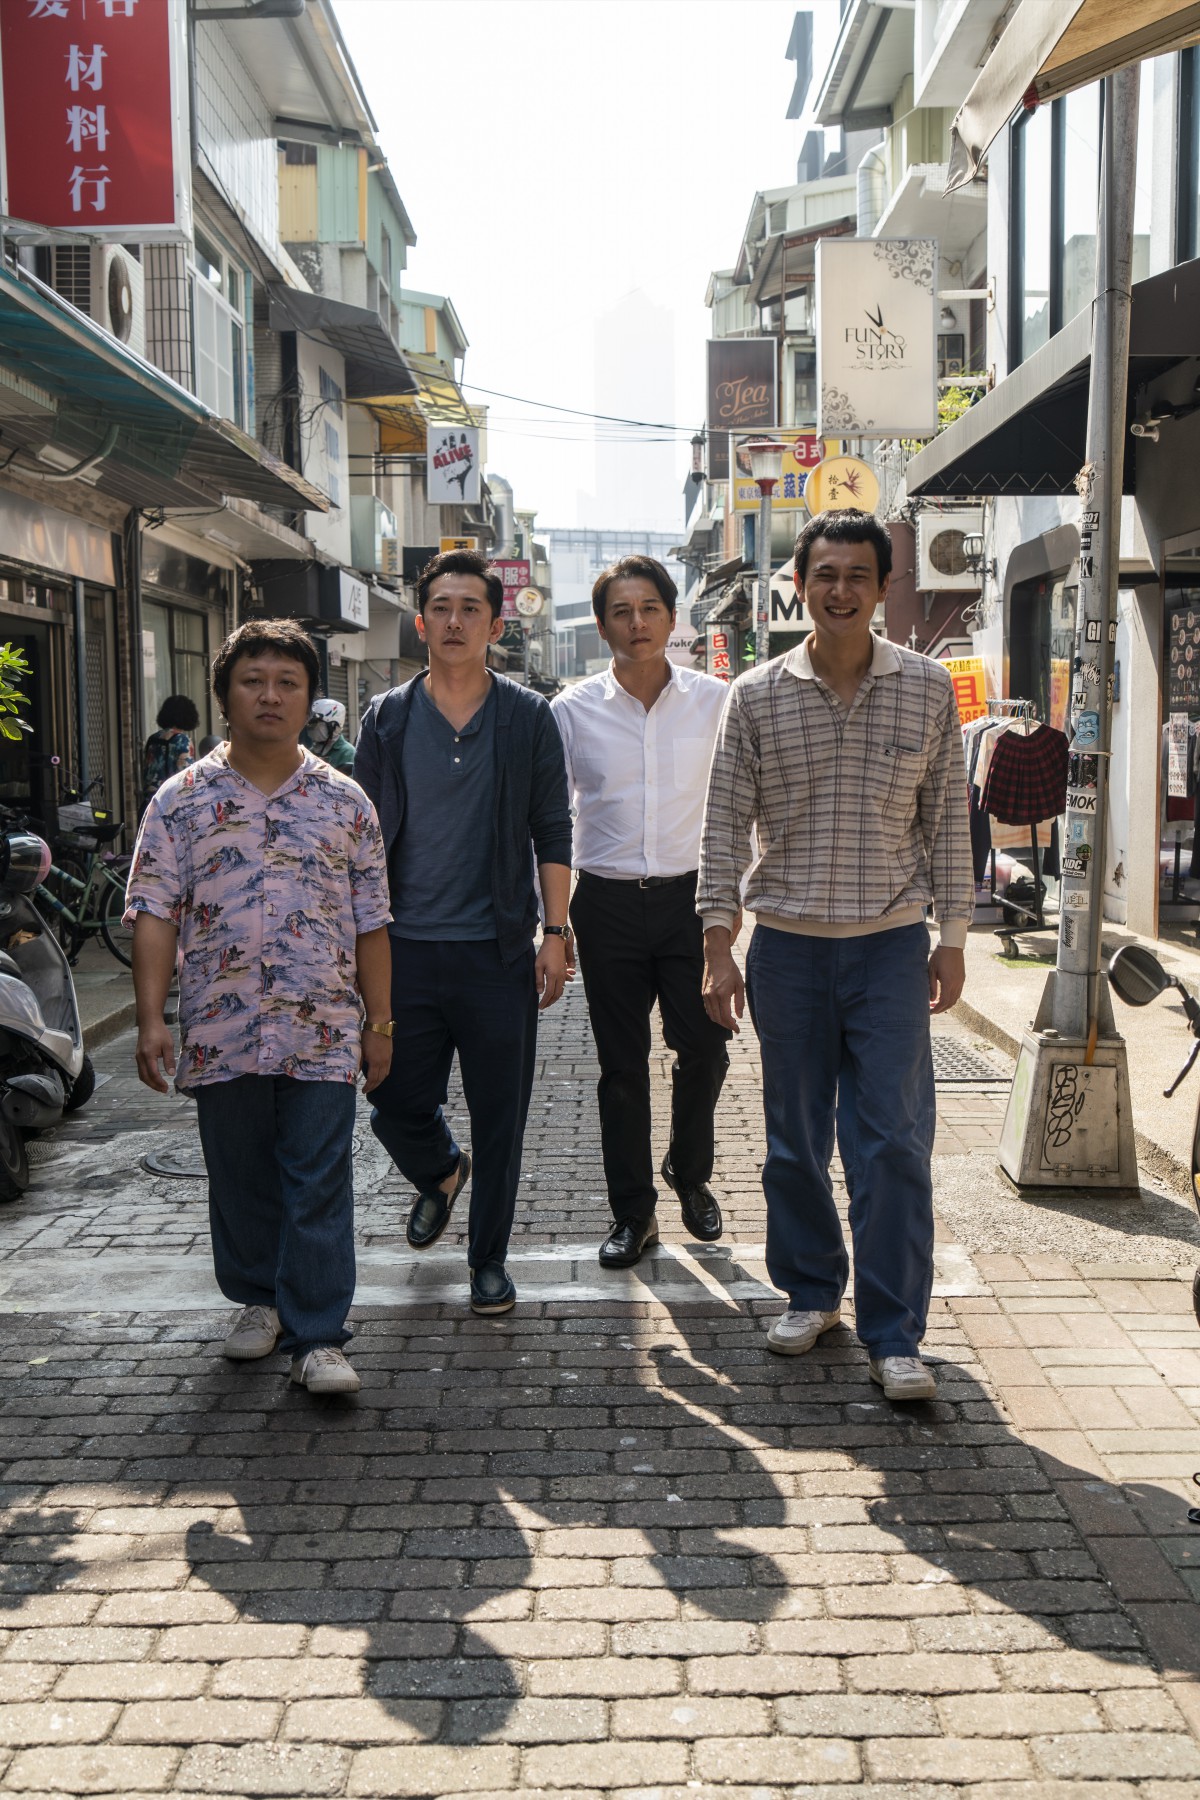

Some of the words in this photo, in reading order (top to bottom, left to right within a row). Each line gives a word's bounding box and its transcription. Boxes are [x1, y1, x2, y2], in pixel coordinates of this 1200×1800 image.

[63, 44, 112, 212] 材料行
[845, 327, 882, 343] FUN
[856, 343, 908, 360] STORY
[715, 376, 770, 417] Tea
[433, 444, 473, 469] ALIVE
[795, 441, 821, 459] 日式
[828, 474, 840, 500] 拾壹
[771, 589, 803, 622] M
